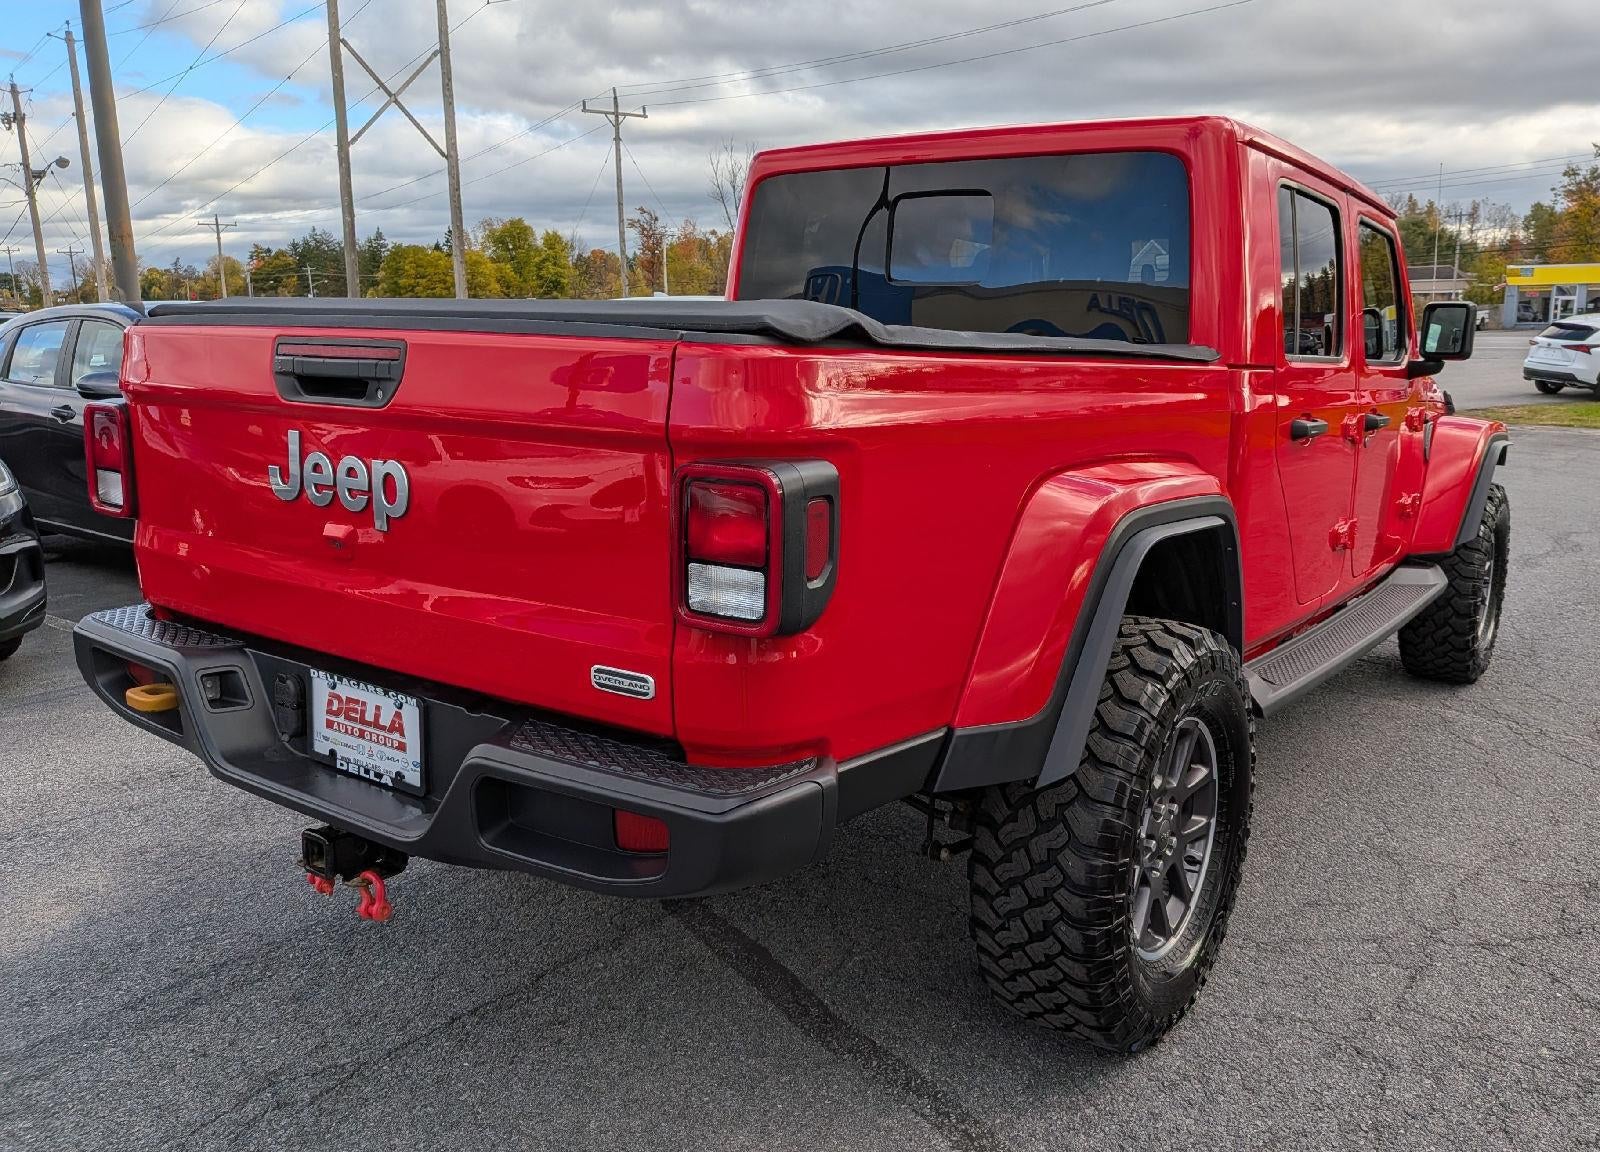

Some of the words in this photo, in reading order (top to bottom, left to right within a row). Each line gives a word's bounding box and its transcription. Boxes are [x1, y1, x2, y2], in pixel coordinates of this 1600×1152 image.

[268, 429, 409, 531] Jeep
[310, 668, 417, 707] DELLACARS.COM
[593, 674, 650, 691] OVERLAND
[325, 691, 406, 740] DELLA
[333, 722, 360, 737] AUTO
[364, 730, 399, 749] GROUP
[336, 759, 394, 787] DELLA
